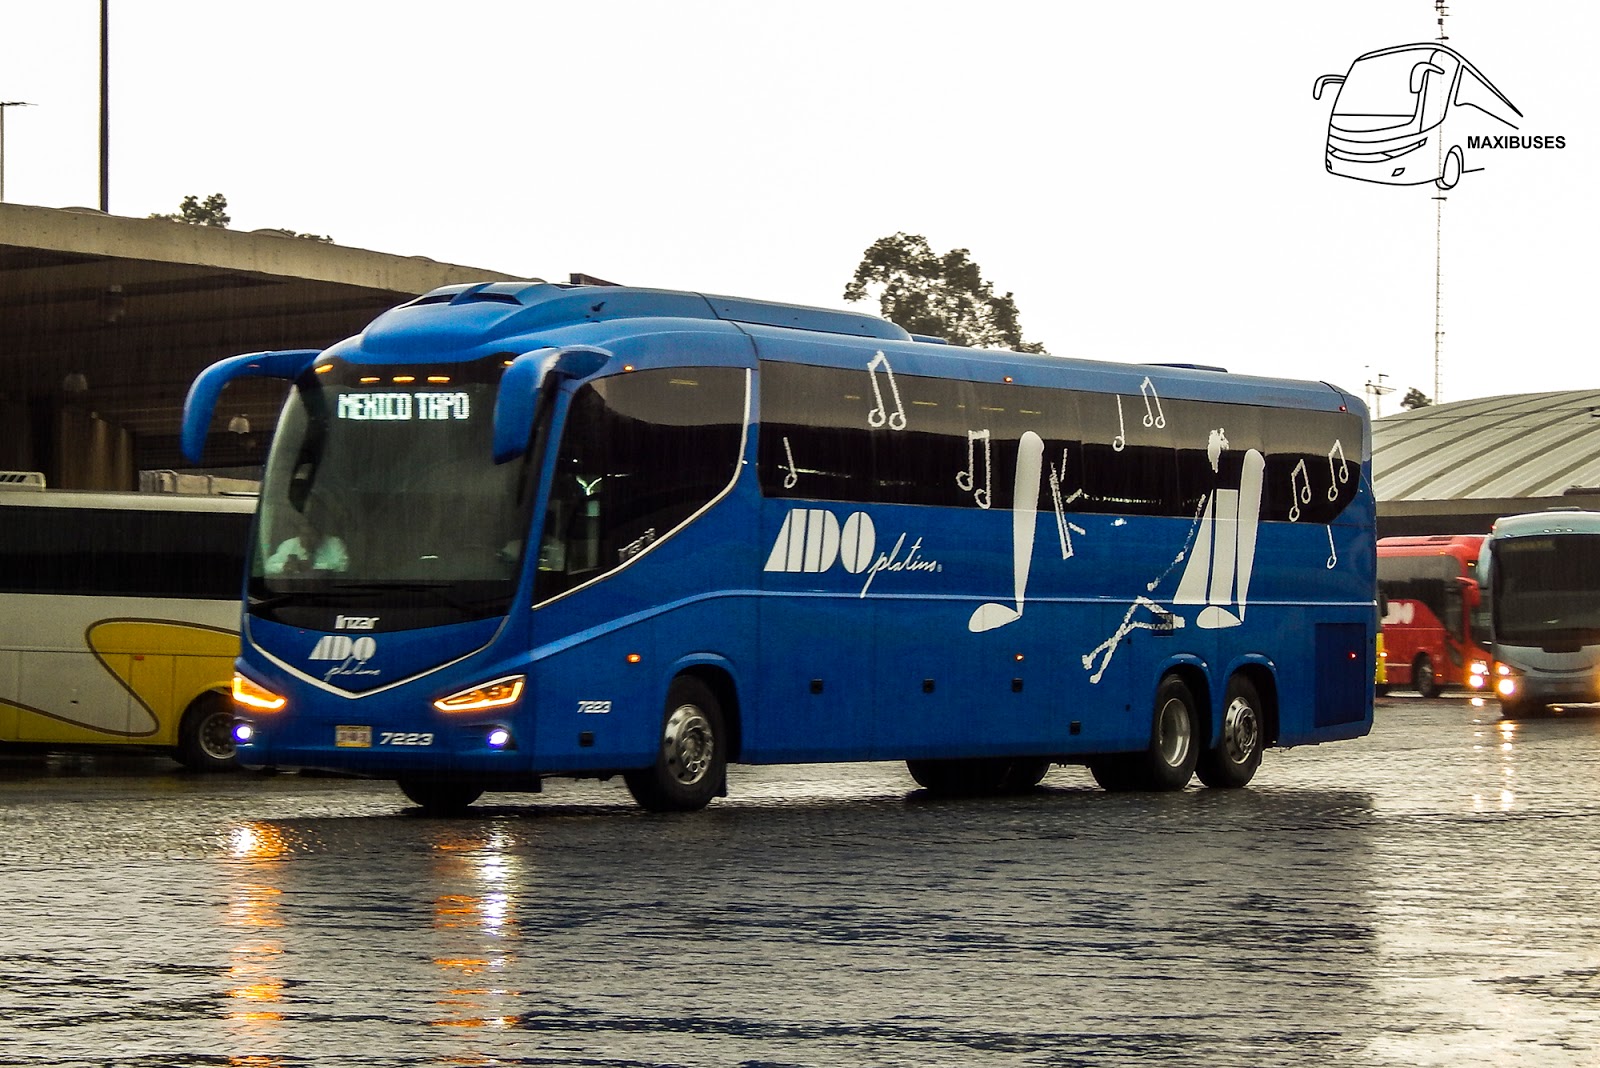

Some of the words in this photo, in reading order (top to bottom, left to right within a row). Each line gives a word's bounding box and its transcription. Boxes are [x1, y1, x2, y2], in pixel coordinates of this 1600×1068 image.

[338, 393, 412, 420] MEXICO
[414, 392, 470, 420] TAPO
[763, 508, 876, 574] ADO
[308, 635, 377, 661] ADO
[577, 700, 612, 714] 7223
[380, 732, 434, 746] 7223
